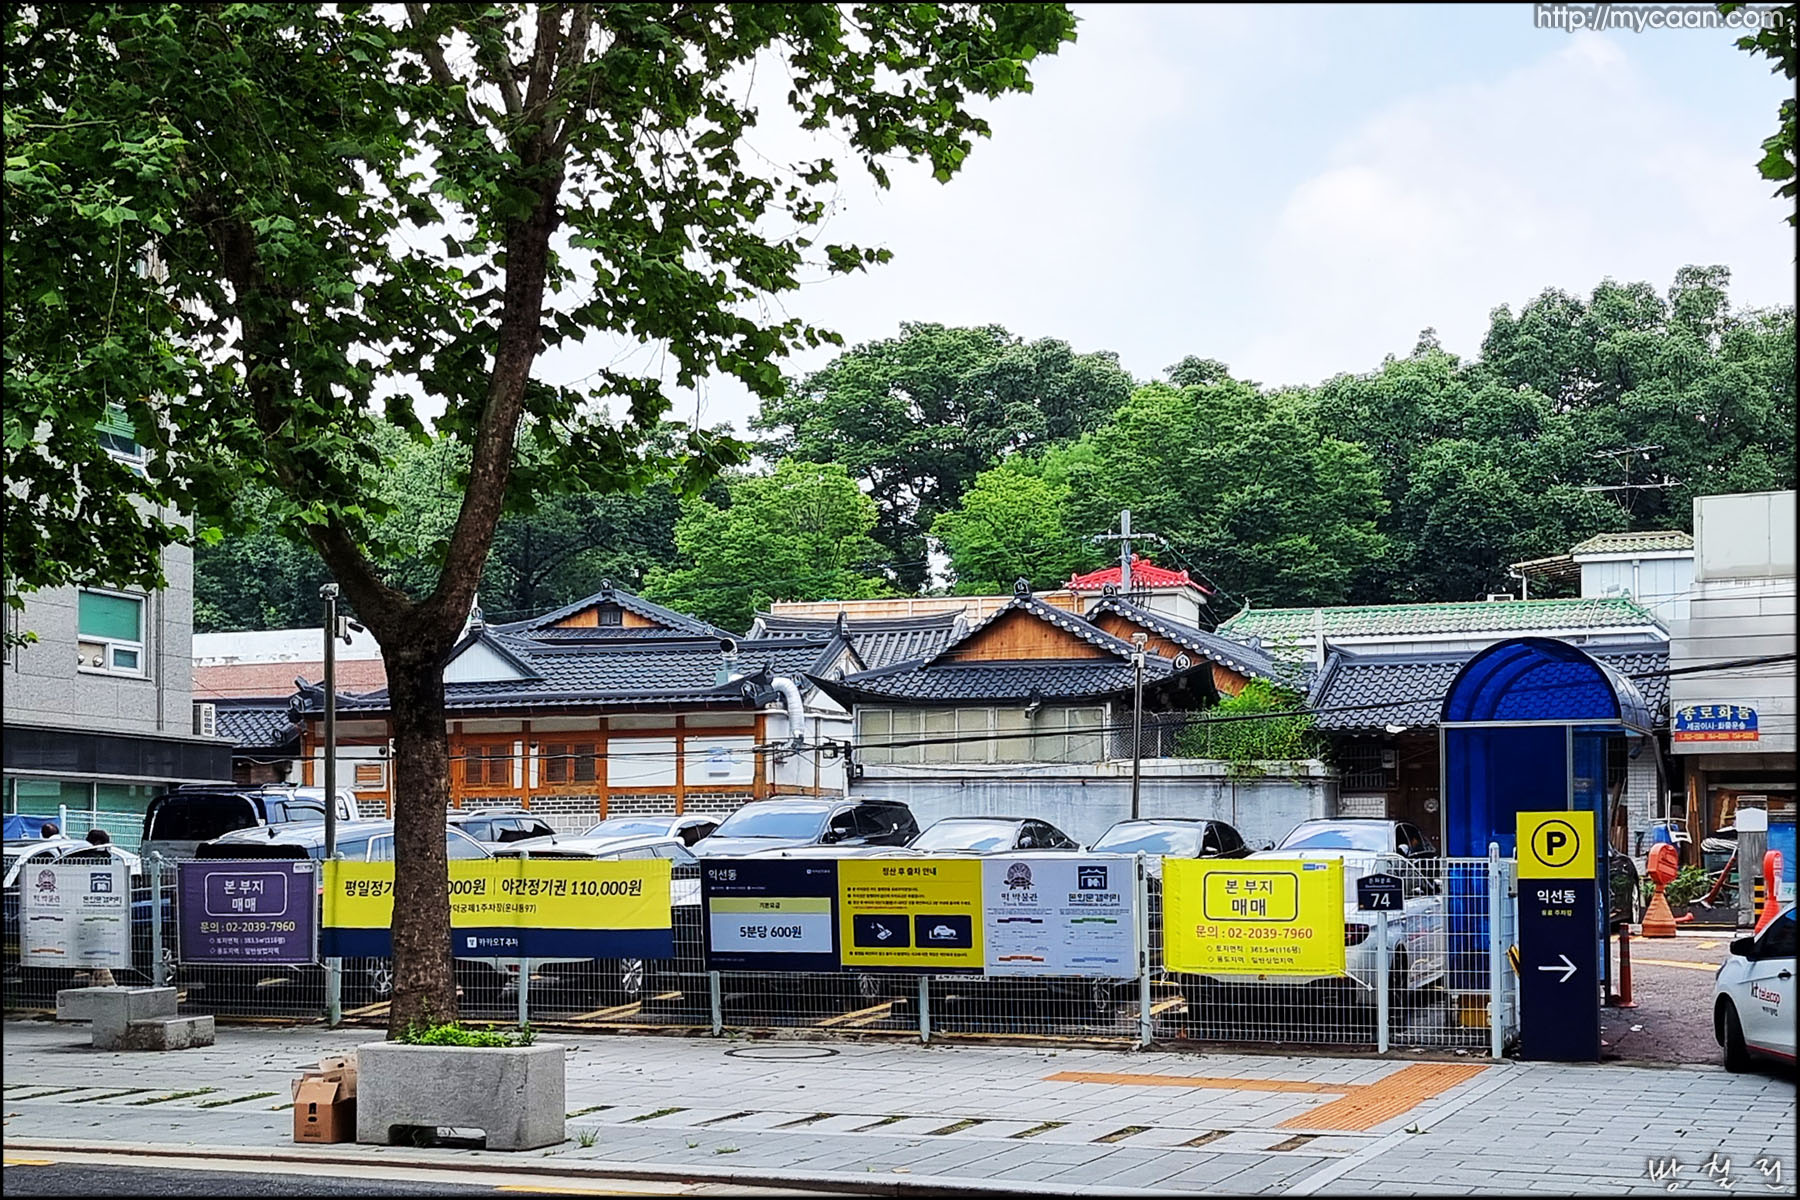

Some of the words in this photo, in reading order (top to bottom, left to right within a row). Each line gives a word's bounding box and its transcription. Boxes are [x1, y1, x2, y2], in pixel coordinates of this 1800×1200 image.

[1546, 831, 1567, 856] P
[708, 869, 737, 881] 익선동
[224, 880, 236, 894] 본
[239, 880, 263, 894] 부지
[345, 880, 392, 896] 평일정기
[502, 878, 567, 896] 야간정기권
[571, 879, 642, 896] 110,000원
[1225, 880, 1239, 894] 본
[1244, 880, 1273, 894] 부지
[1370, 893, 1391, 908] 74
[1537, 889, 1576, 904] 익선동
[232, 897, 256, 912] 매매
[1232, 898, 1266, 916] 매매
[201, 922, 219, 934] 문의
[226, 921, 295, 932] 02-2039-7960
[740, 926, 767, 938] 5분당
[770, 926, 802, 938] 600원
[1196, 925, 1218, 939] 문의
[1228, 927, 1313, 939] 02-2039-7960
